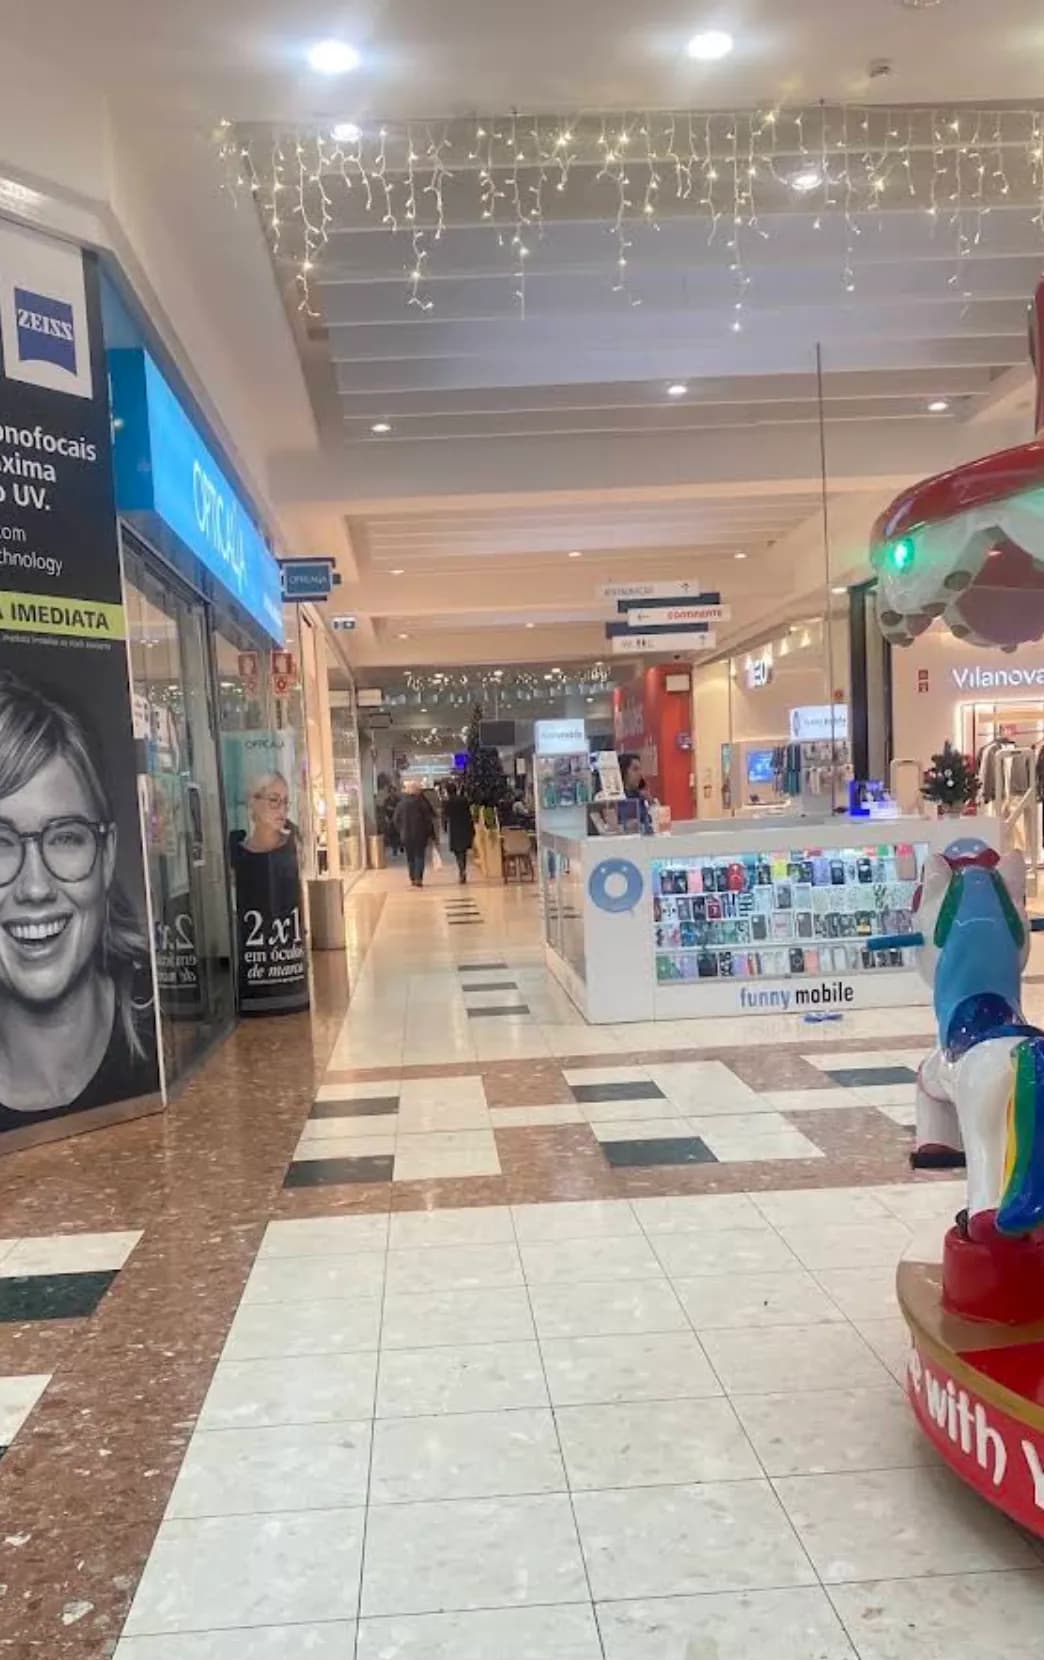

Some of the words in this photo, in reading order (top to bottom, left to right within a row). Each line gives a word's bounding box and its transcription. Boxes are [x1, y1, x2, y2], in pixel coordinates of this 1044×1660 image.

[18, 308, 73, 341] ZEISS
[0, 451, 56, 483] xima
[12, 483, 51, 511] UV.
[11, 602, 110, 631] IMEDIATA
[244, 951, 267, 963] em
[247, 963, 266, 979] de
[740, 987, 791, 1010] funny
[795, 981, 854, 1005] mobile
[925, 1368, 1007, 1487] with
